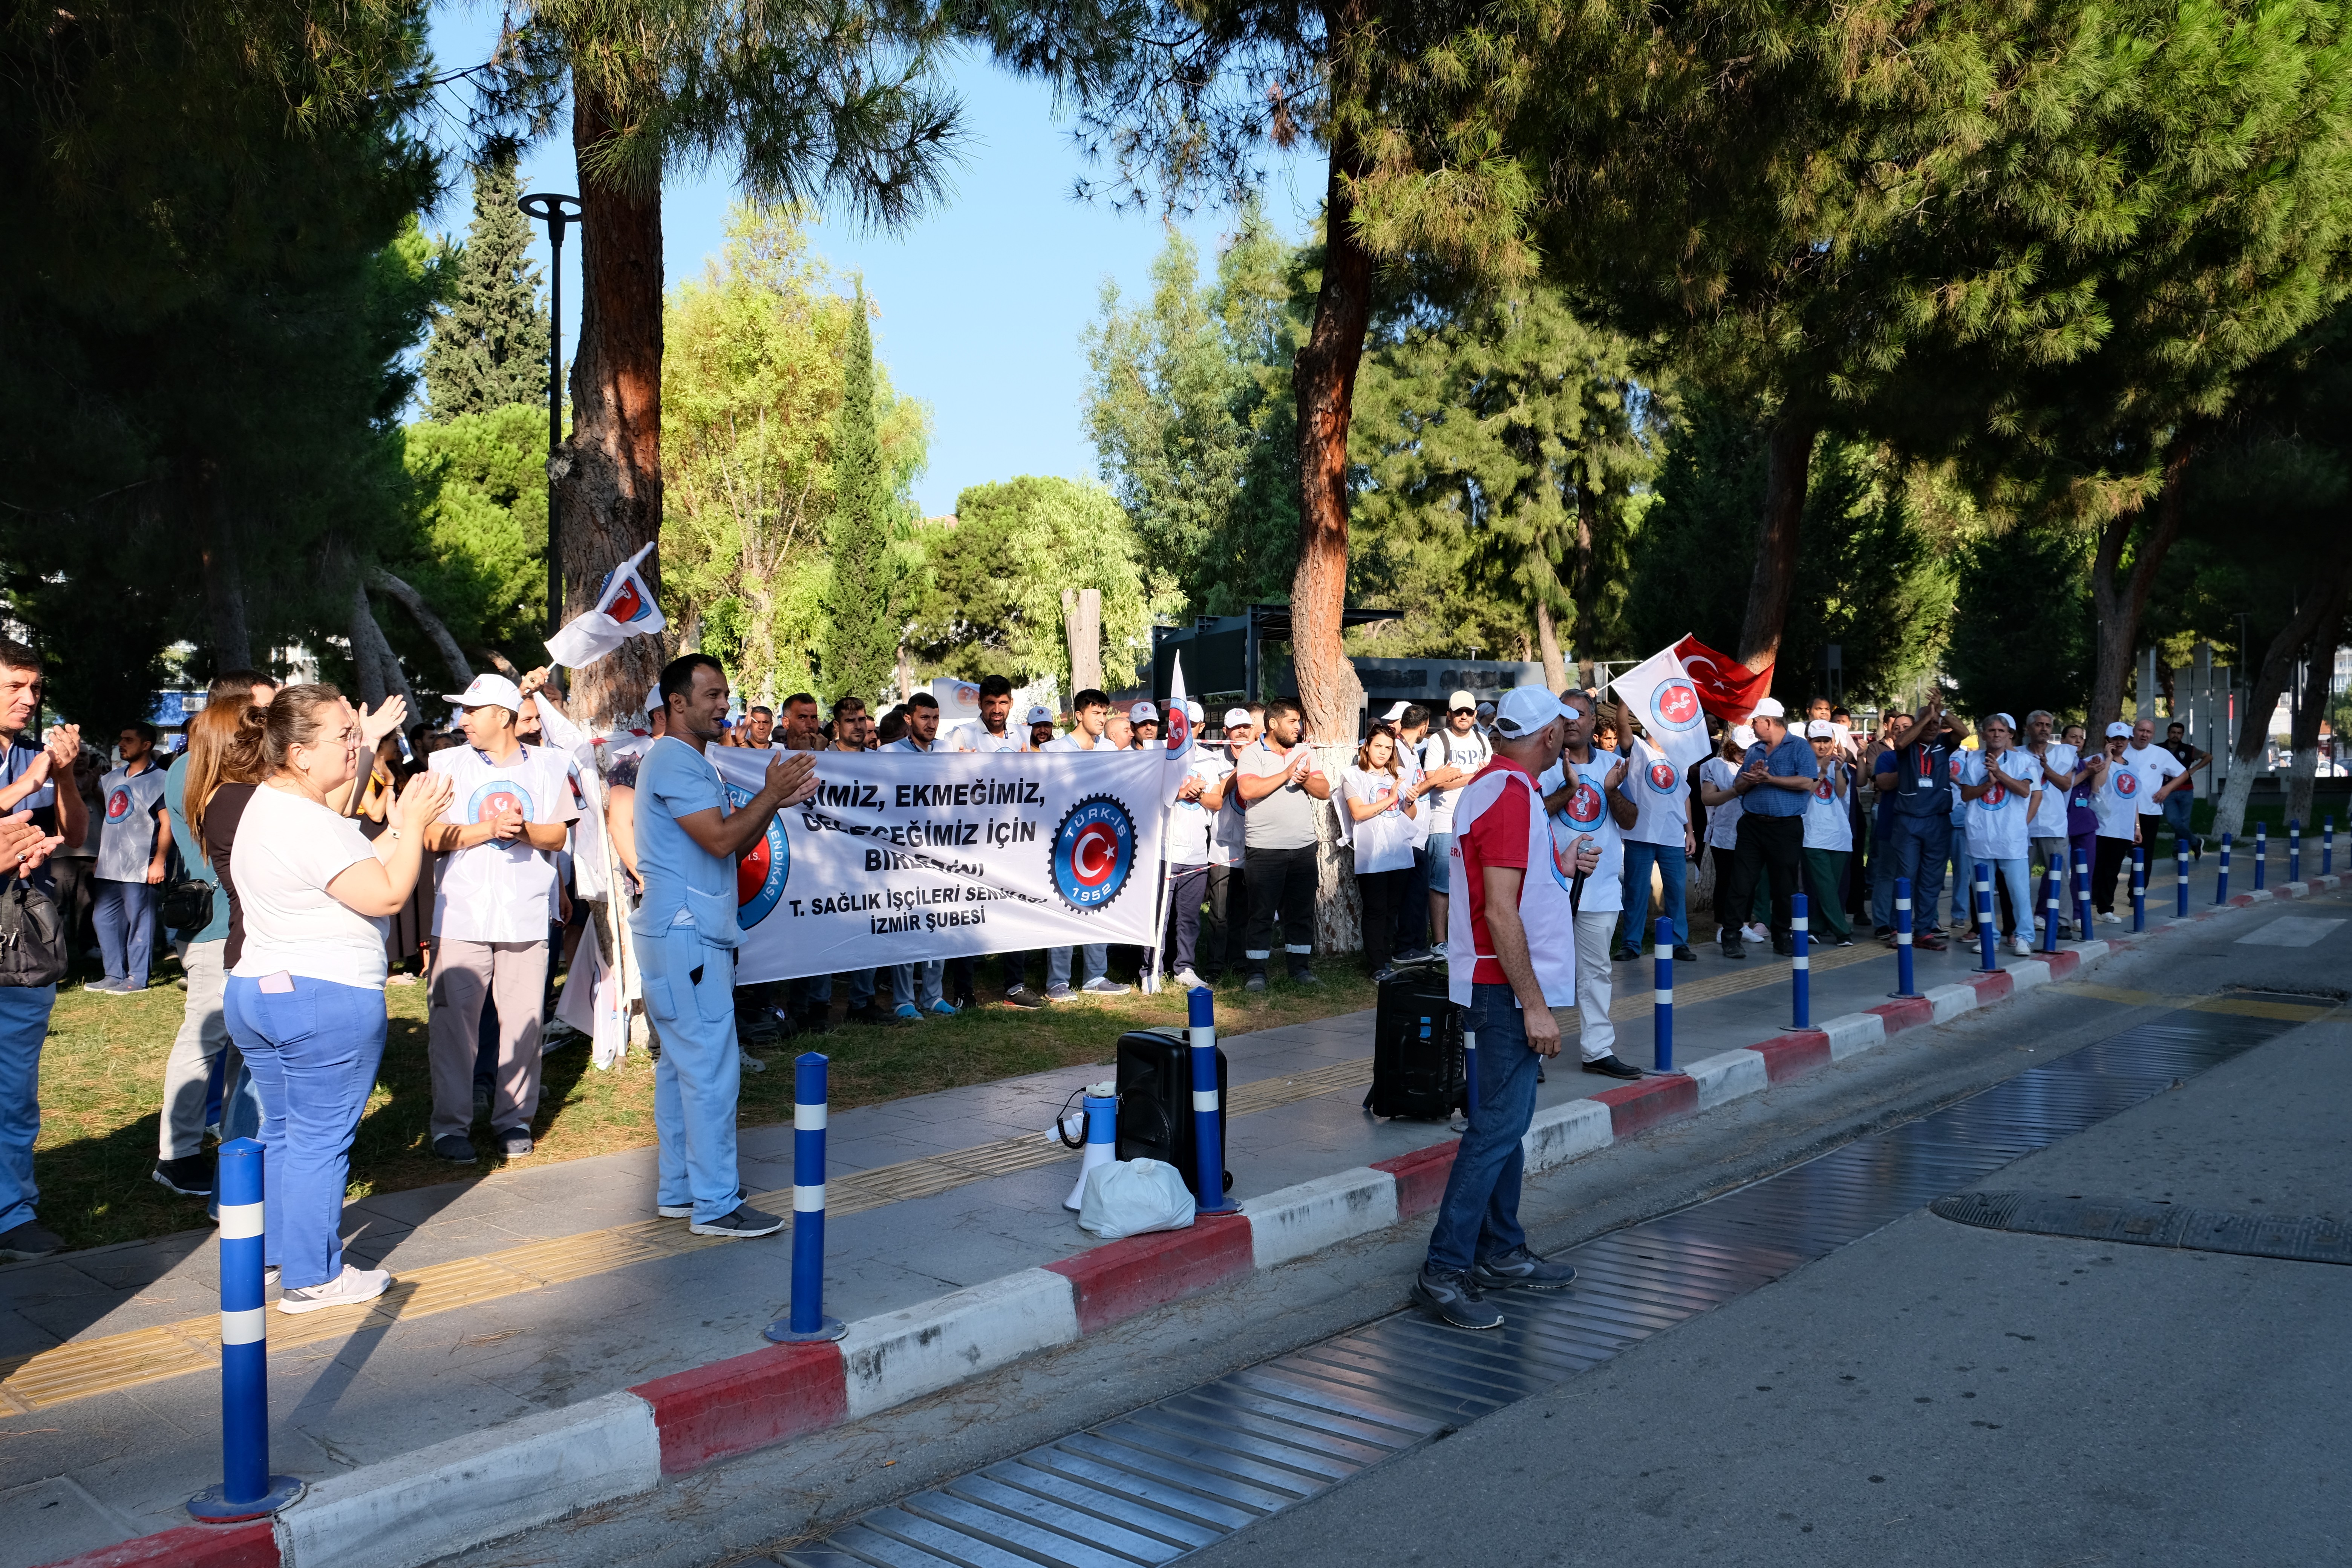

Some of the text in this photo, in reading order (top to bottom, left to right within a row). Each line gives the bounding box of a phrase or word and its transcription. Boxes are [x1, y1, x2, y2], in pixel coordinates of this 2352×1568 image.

[895, 777, 1045, 808] EKMEĞİMİZ,
[986, 817, 1036, 849] İÇİN
[1065, 807, 1126, 837] TÜRK-İŞ
[763, 821, 785, 901] SENDİKASI
[789, 900, 805, 917] T.
[811, 892, 882, 915] SAĞLIK
[887, 884, 960, 912] İŞÇİLERİ
[1073, 883, 1112, 901] 1952
[871, 905, 986, 935] İZMİR ŞUBESİ
